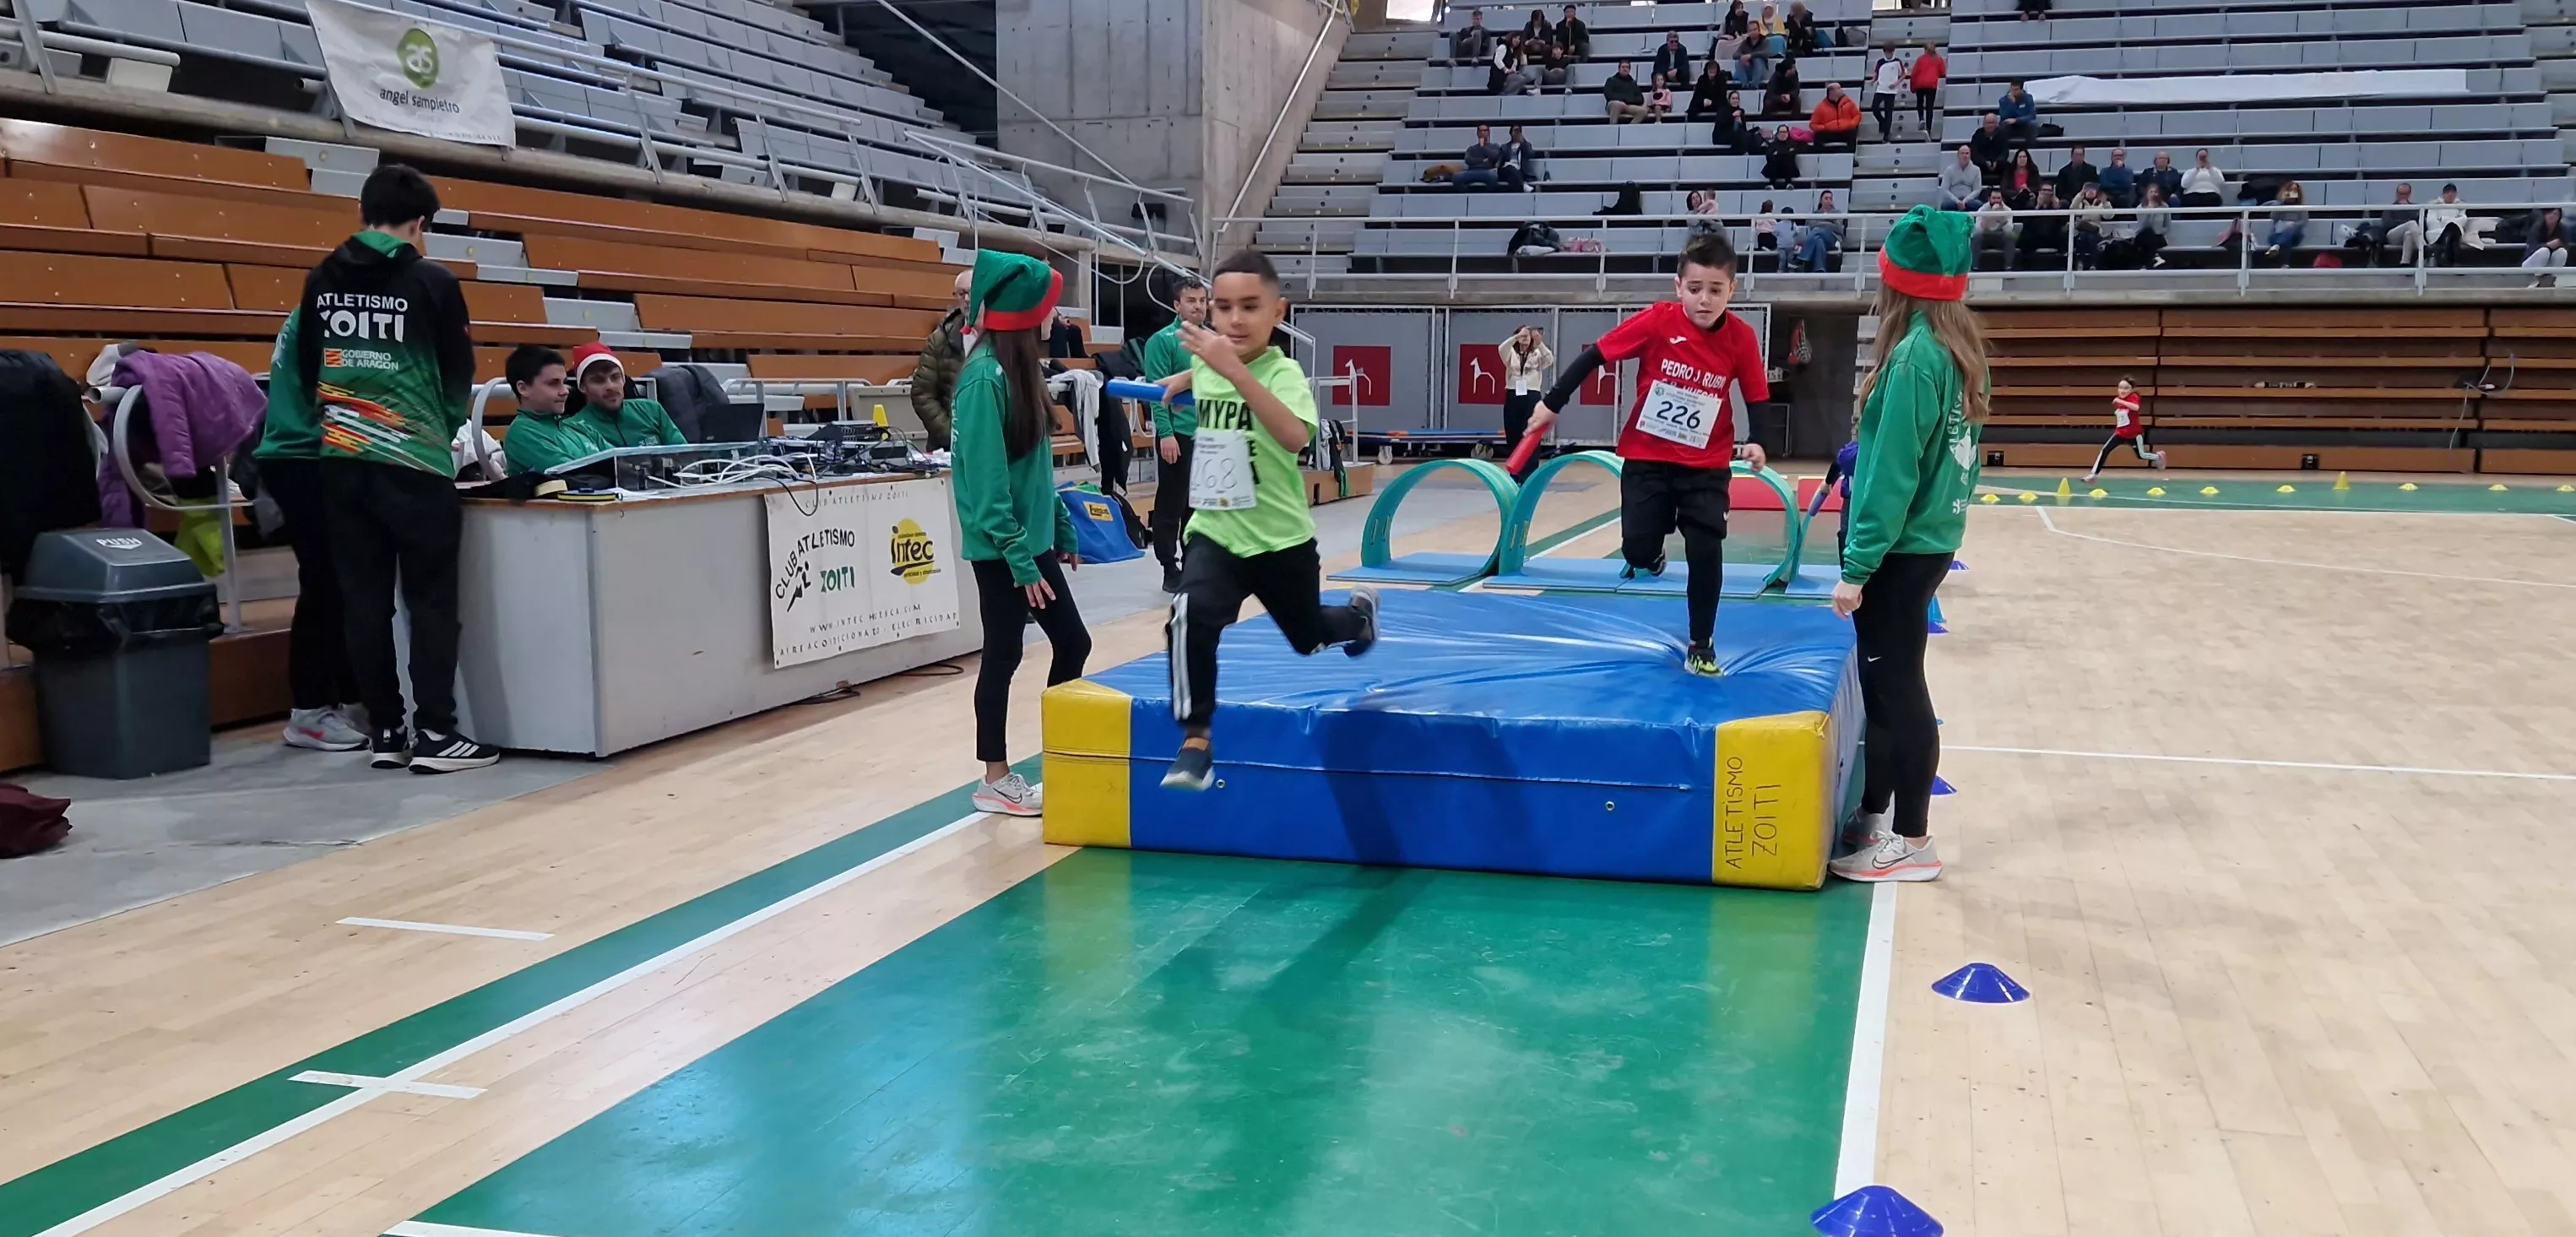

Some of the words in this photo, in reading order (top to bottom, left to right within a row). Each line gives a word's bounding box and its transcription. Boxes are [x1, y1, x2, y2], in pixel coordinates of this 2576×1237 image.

[379, 88, 409, 106] angel
[412, 95, 460, 114] sampietro
[317, 292, 408, 312] ATLETISMO
[342, 349, 392, 361] GOBIERNO
[342, 359, 355, 367] DE
[1661, 358, 1694, 381] PEDRO
[1656, 400, 1701, 430] 226
[775, 550, 799, 600] CLUB
[797, 529, 856, 557] ATLETISMO
